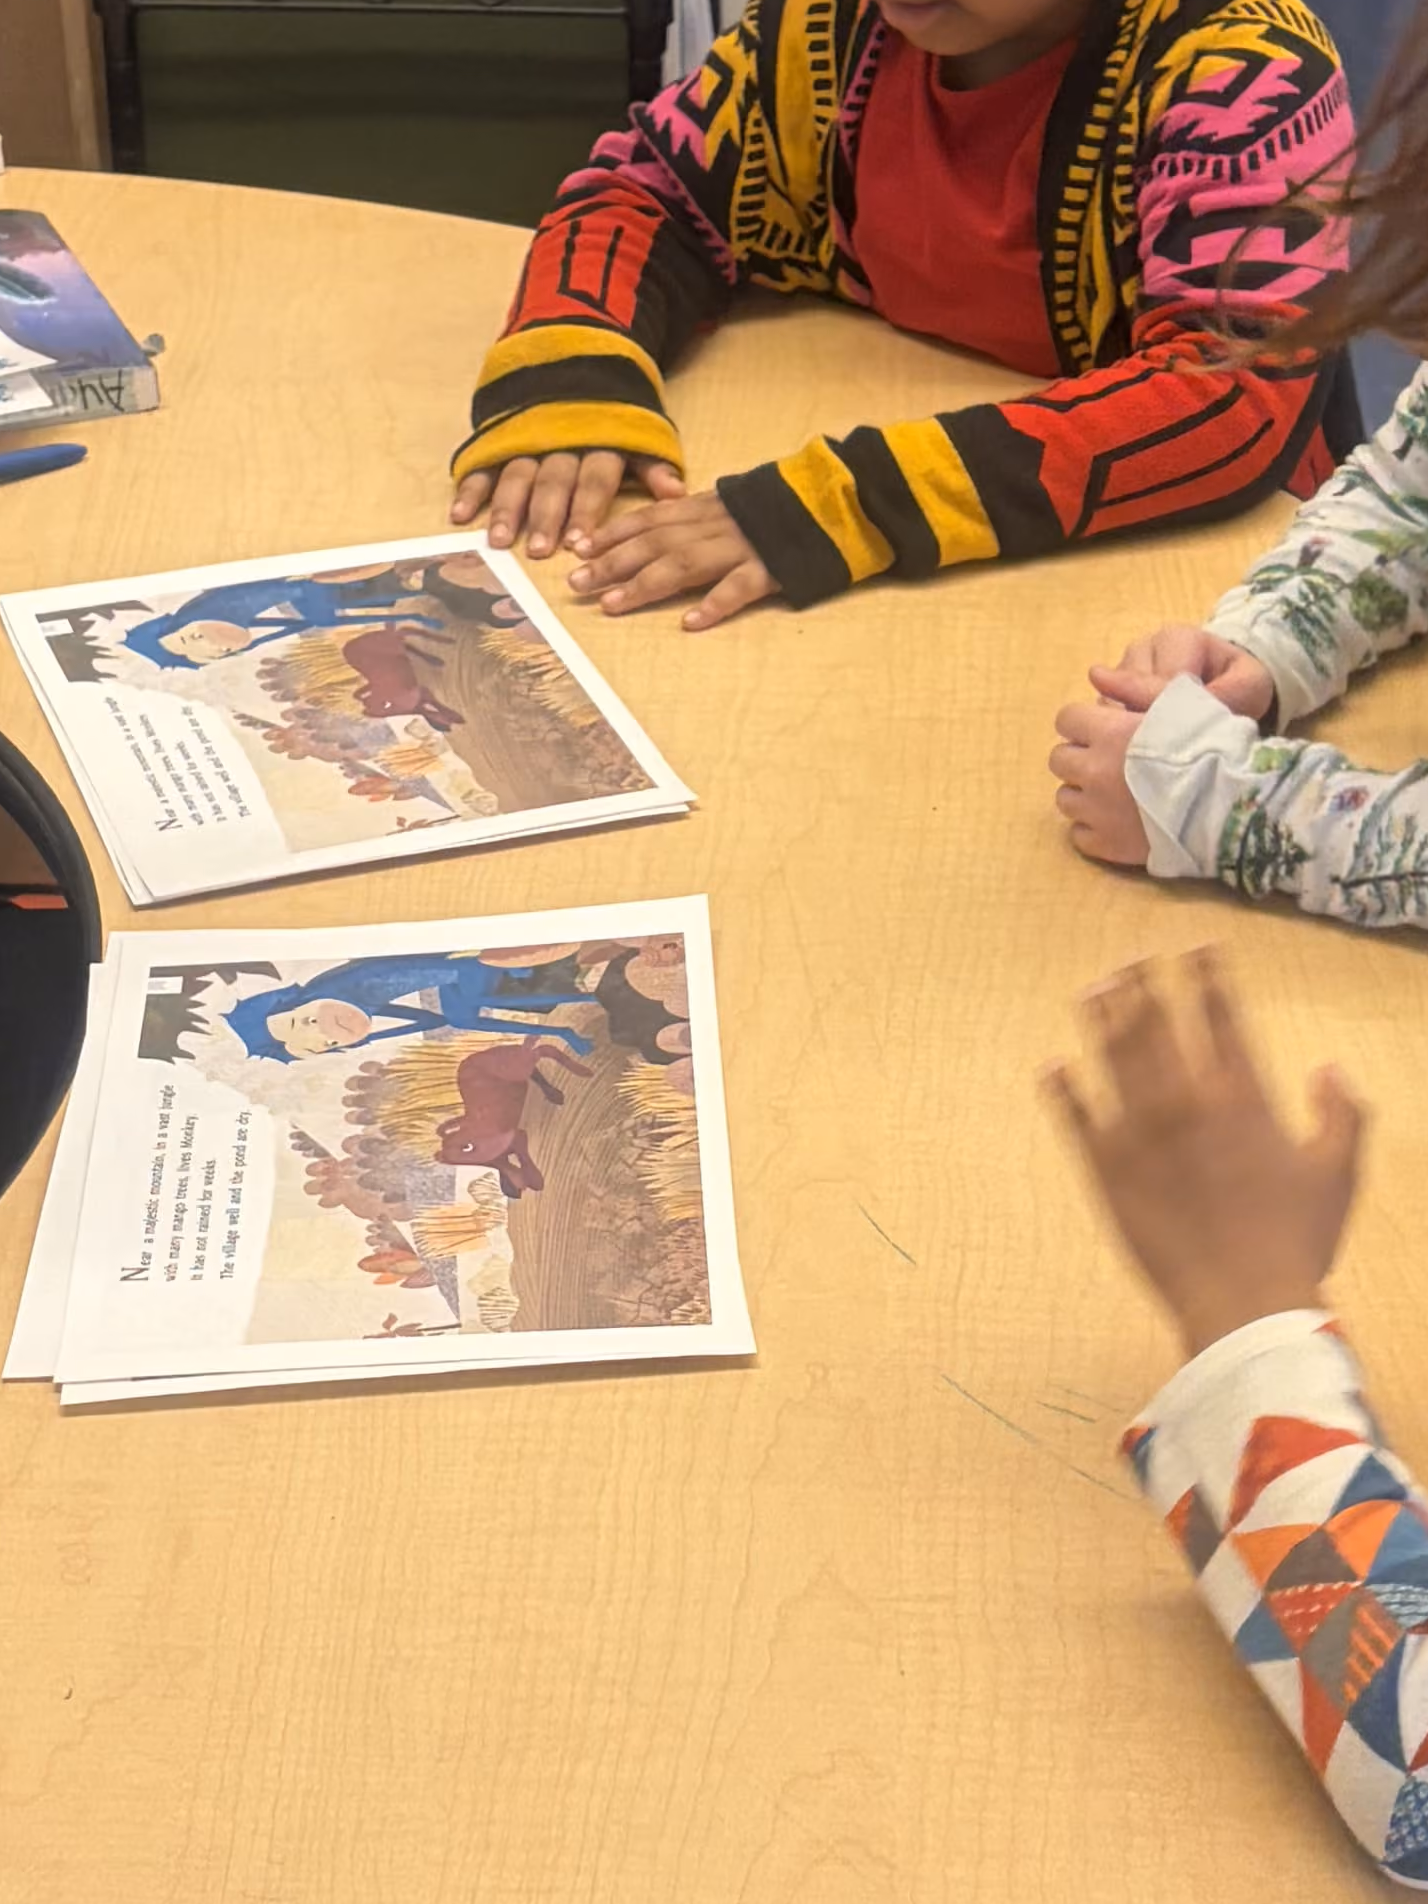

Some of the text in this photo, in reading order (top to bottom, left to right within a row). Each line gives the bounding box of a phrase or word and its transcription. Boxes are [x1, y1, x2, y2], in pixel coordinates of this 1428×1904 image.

[158, 1112, 170, 1130] vast
[180, 1113, 200, 1149] Monkey.
[154, 1141, 167, 1150] in
[176, 1151, 192, 1173] lives
[149, 1153, 167, 1195] mountain,
[199, 1188, 213, 1202] for
[220, 1109, 252, 1280] The village well and the pond are dry.
[143, 1198, 160, 1235] majestic
[172, 1201, 188, 1232] mango
[196, 1204, 212, 1233] rained
[169, 1236, 185, 1259] many
[195, 1236, 208, 1251] not
[120, 1250, 152, 1282] Near
[164, 1263, 178, 1282] with
[190, 1254, 206, 1271] has
